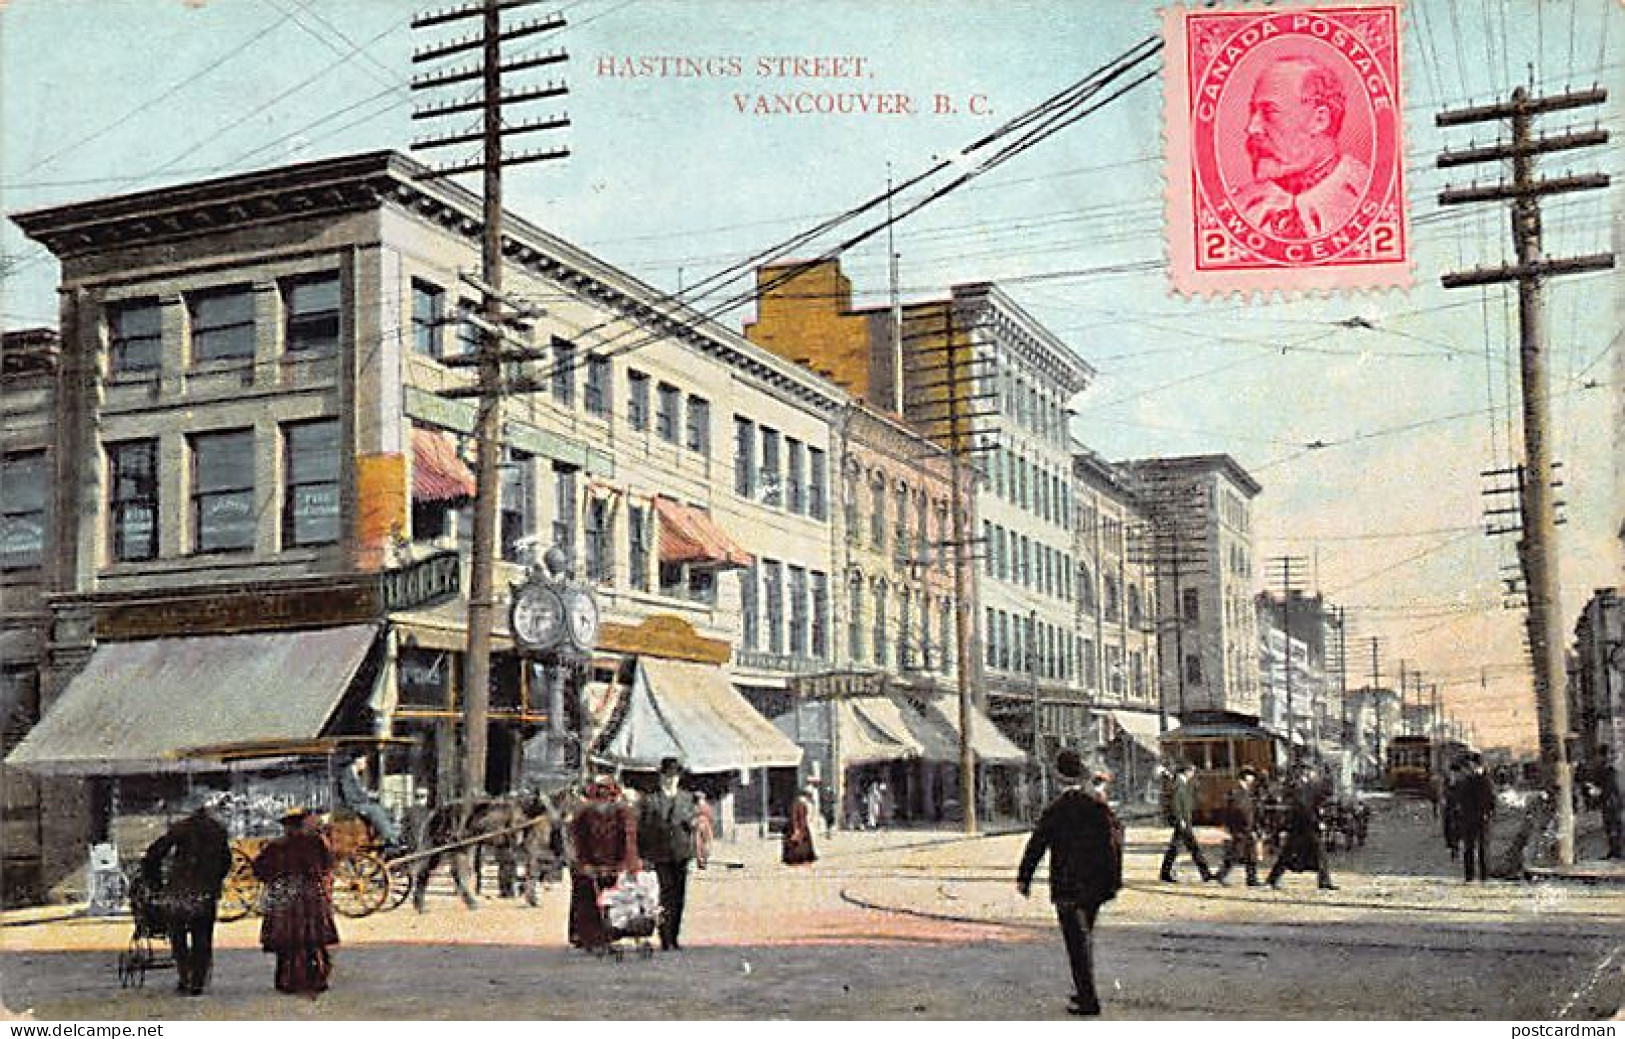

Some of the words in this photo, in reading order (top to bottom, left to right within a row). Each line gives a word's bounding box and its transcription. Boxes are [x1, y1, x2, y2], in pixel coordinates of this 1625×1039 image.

[1199, 21, 1278, 122] CANADA
[1292, 15, 1392, 110] POSTAGE
[1205, 234, 1225, 259] 2
[1217, 202, 1266, 251] TWO
[1285, 200, 1378, 262] CENTS
[1374, 227, 1394, 252] 2
